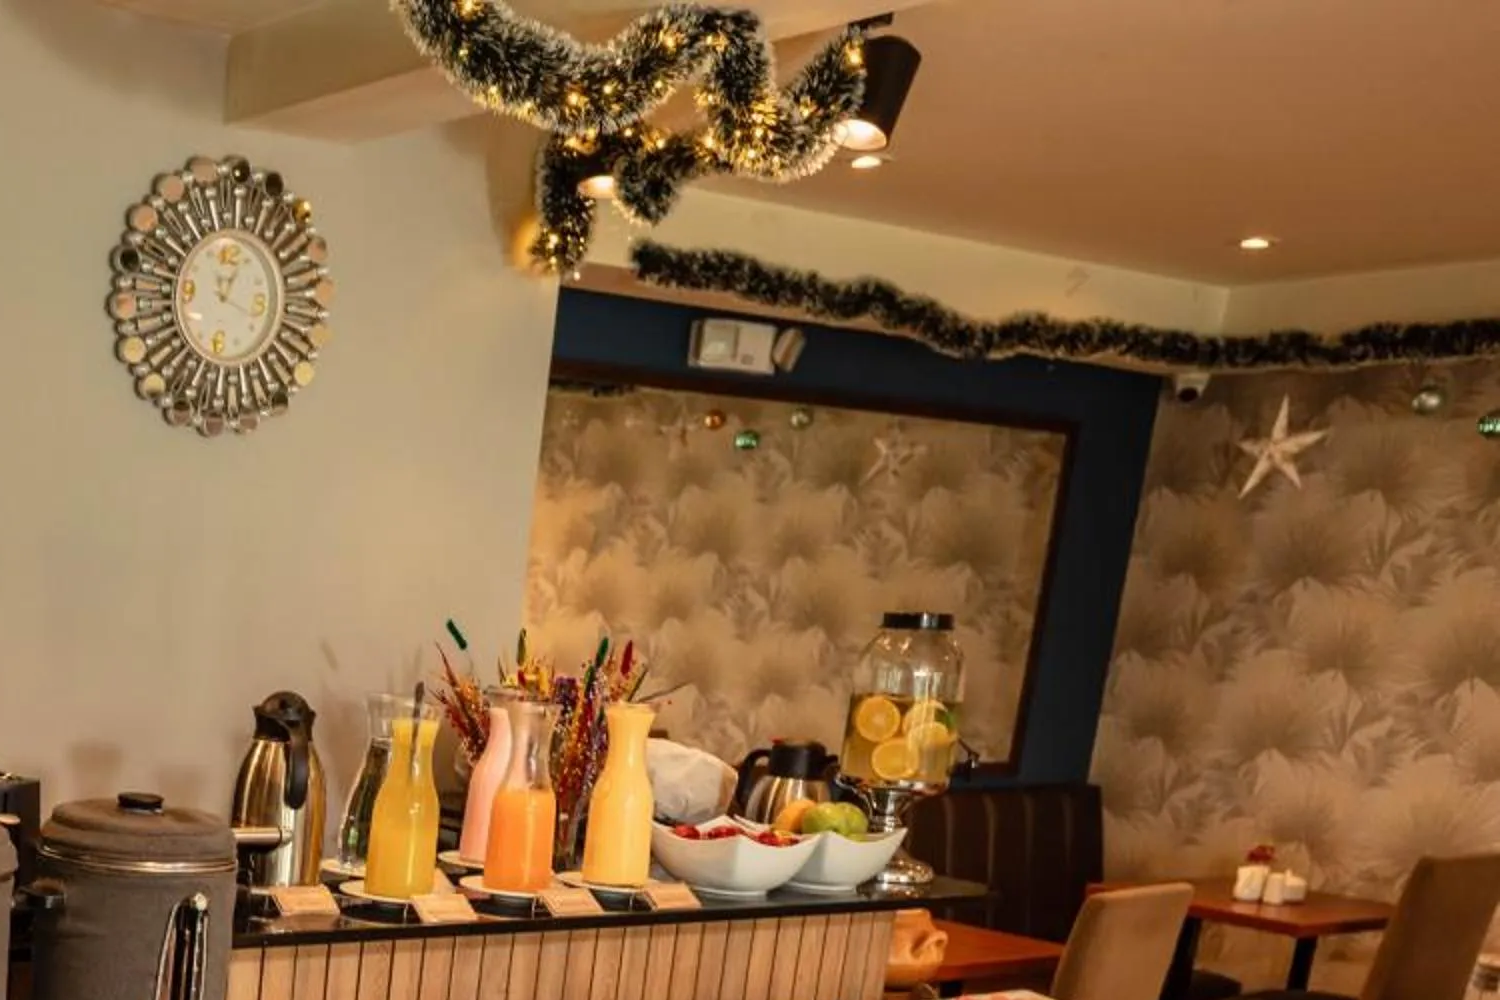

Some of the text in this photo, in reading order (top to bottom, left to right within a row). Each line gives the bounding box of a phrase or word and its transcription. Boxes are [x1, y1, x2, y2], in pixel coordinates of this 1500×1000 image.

[218, 244, 241, 265] 12
[182, 280, 195, 304] 9
[250, 292, 266, 317] 3
[212, 330, 226, 353] 6
